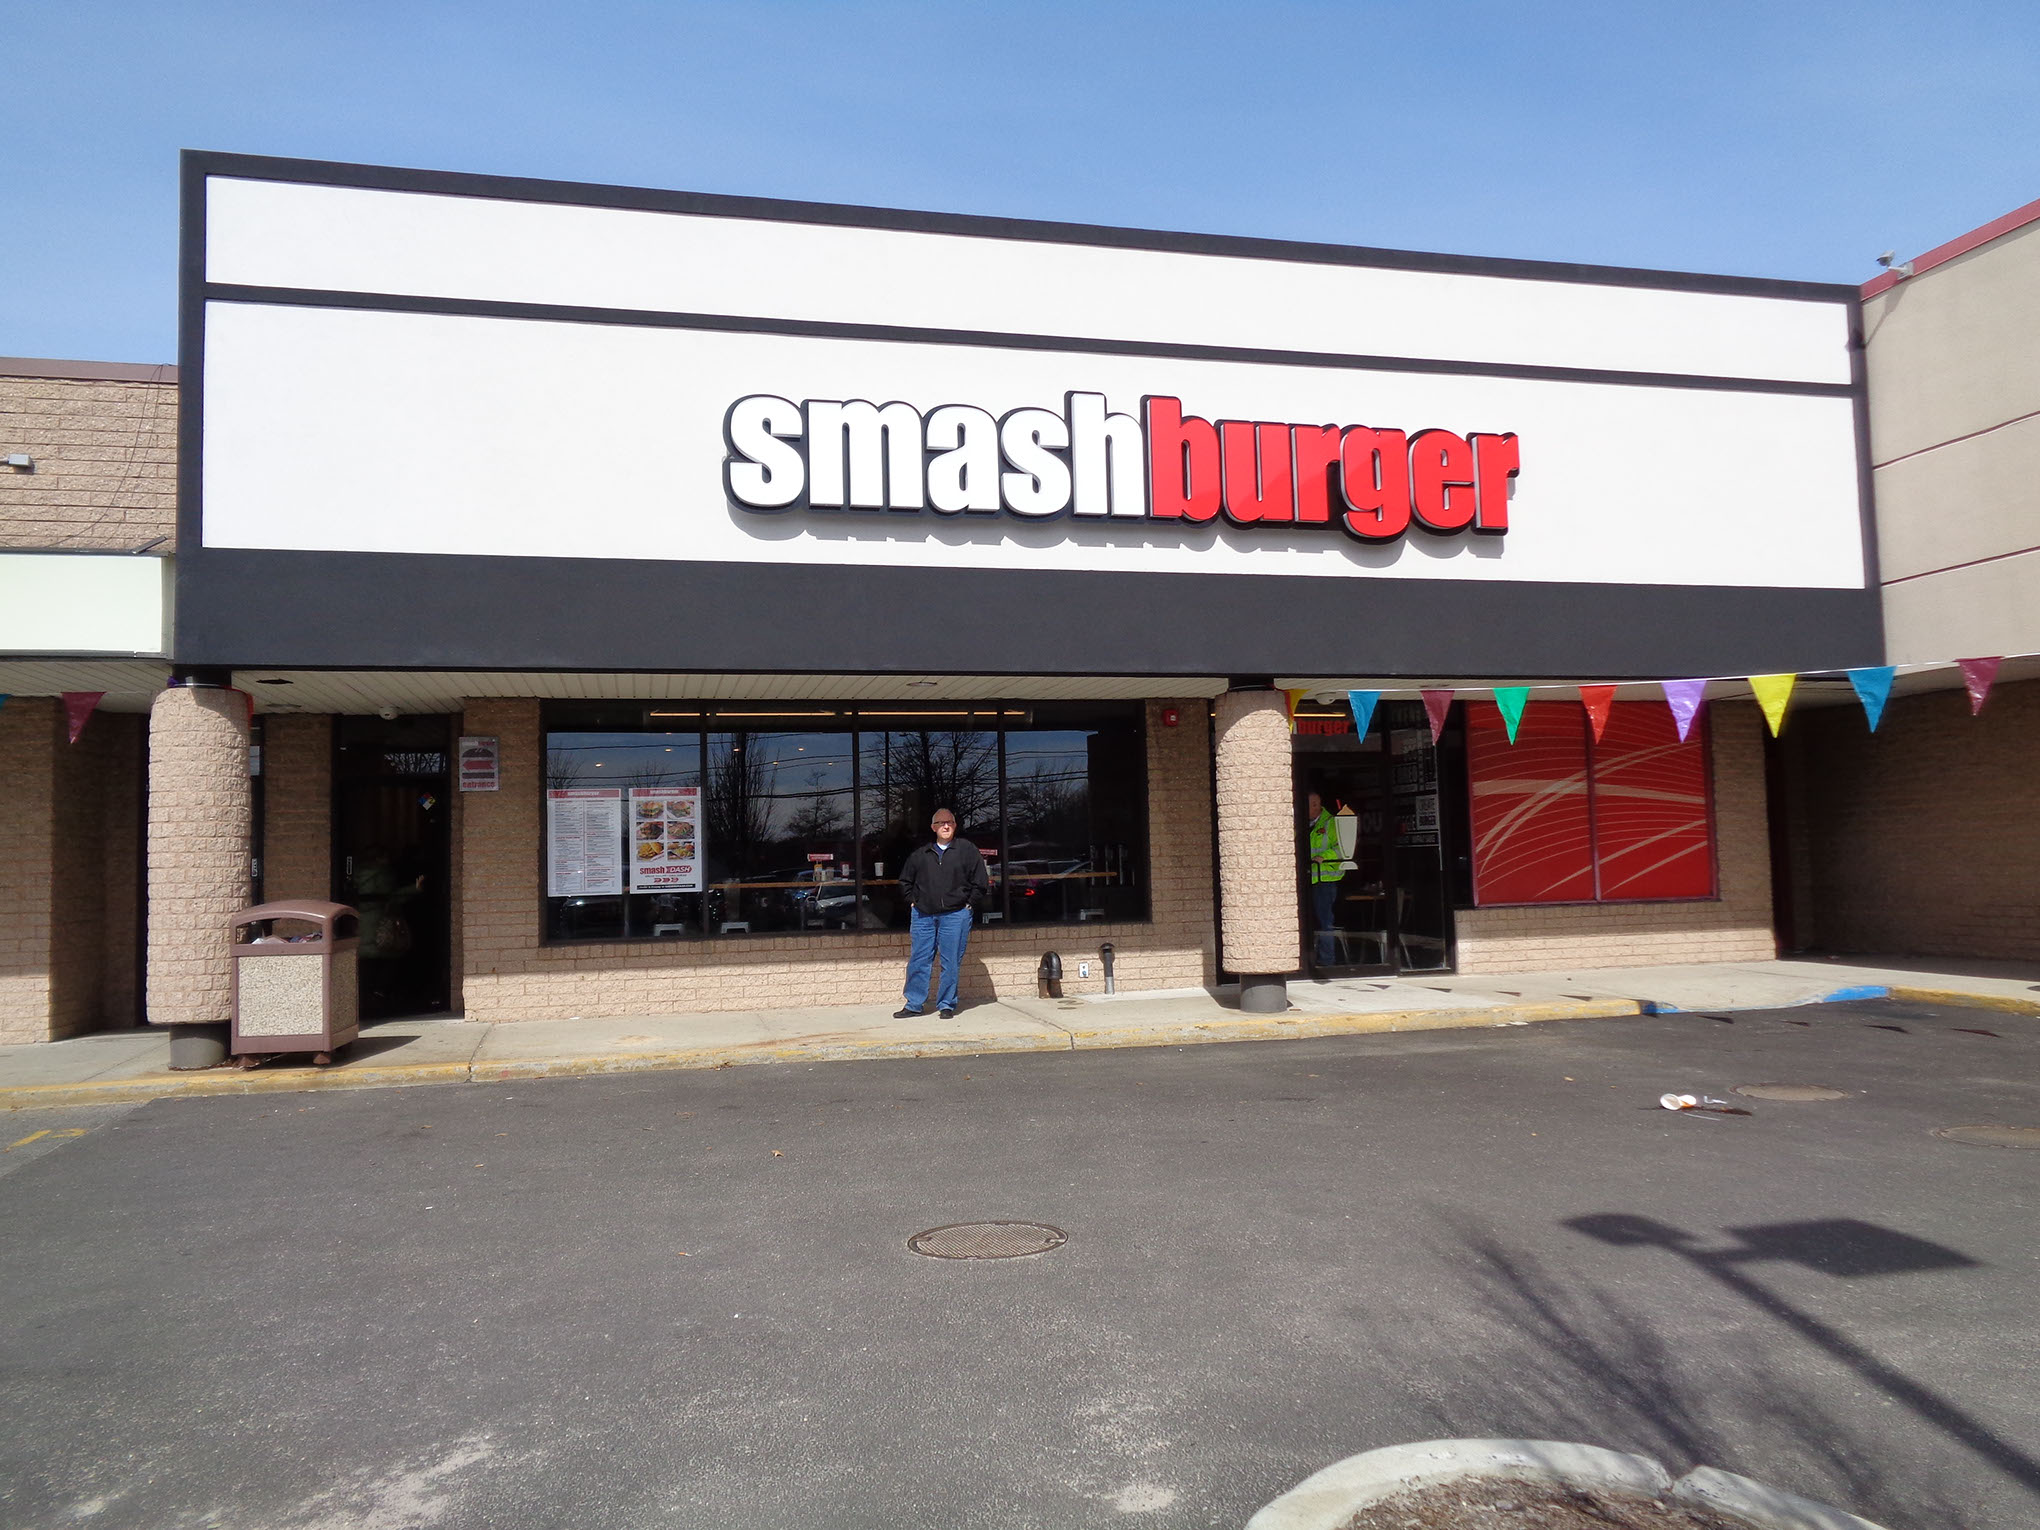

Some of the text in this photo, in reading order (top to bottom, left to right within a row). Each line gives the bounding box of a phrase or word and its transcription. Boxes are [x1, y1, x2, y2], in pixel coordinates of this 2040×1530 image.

[724, 391, 1519, 546] smashburger
[639, 865, 691, 875] smash DASH
